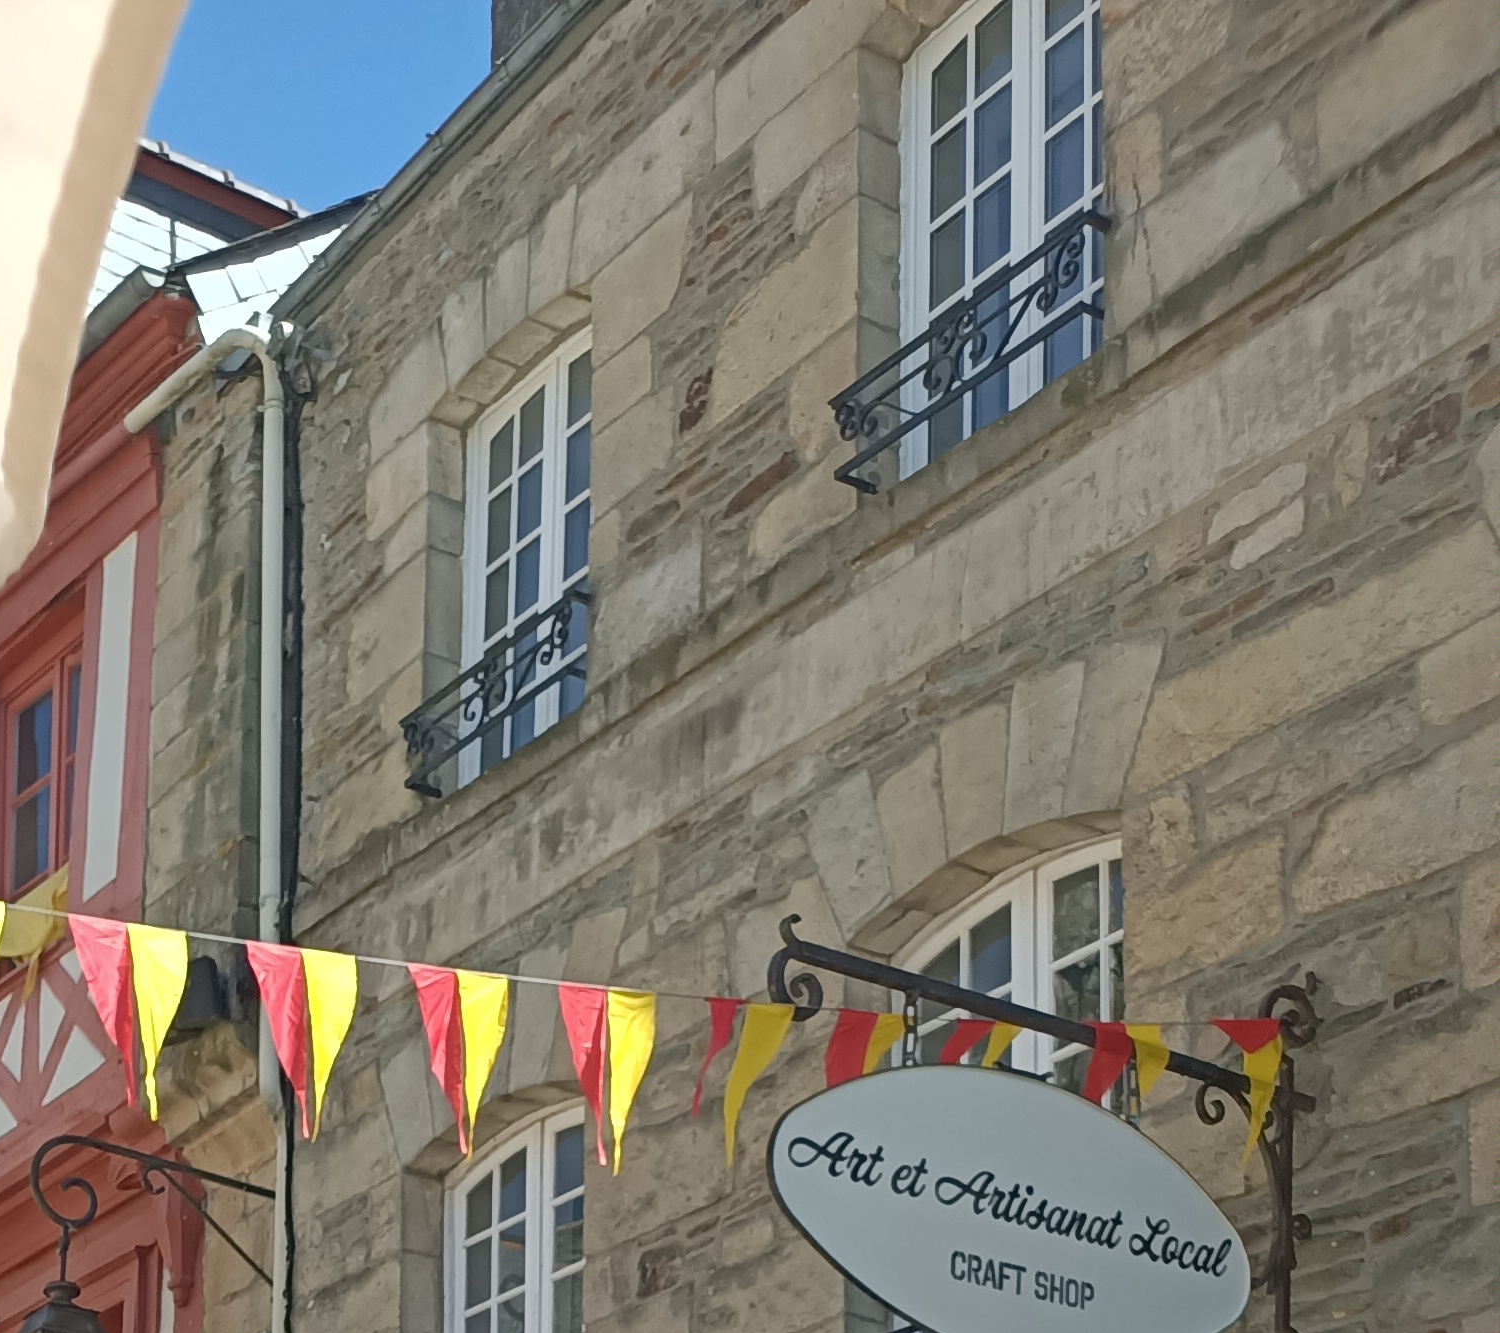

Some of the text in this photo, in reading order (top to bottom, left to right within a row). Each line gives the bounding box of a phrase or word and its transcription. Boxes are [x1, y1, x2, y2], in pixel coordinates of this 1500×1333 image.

[786, 1131, 1234, 1278] Art et Artisanat Local
[949, 1250, 1096, 1311] CRAFT SHOP
